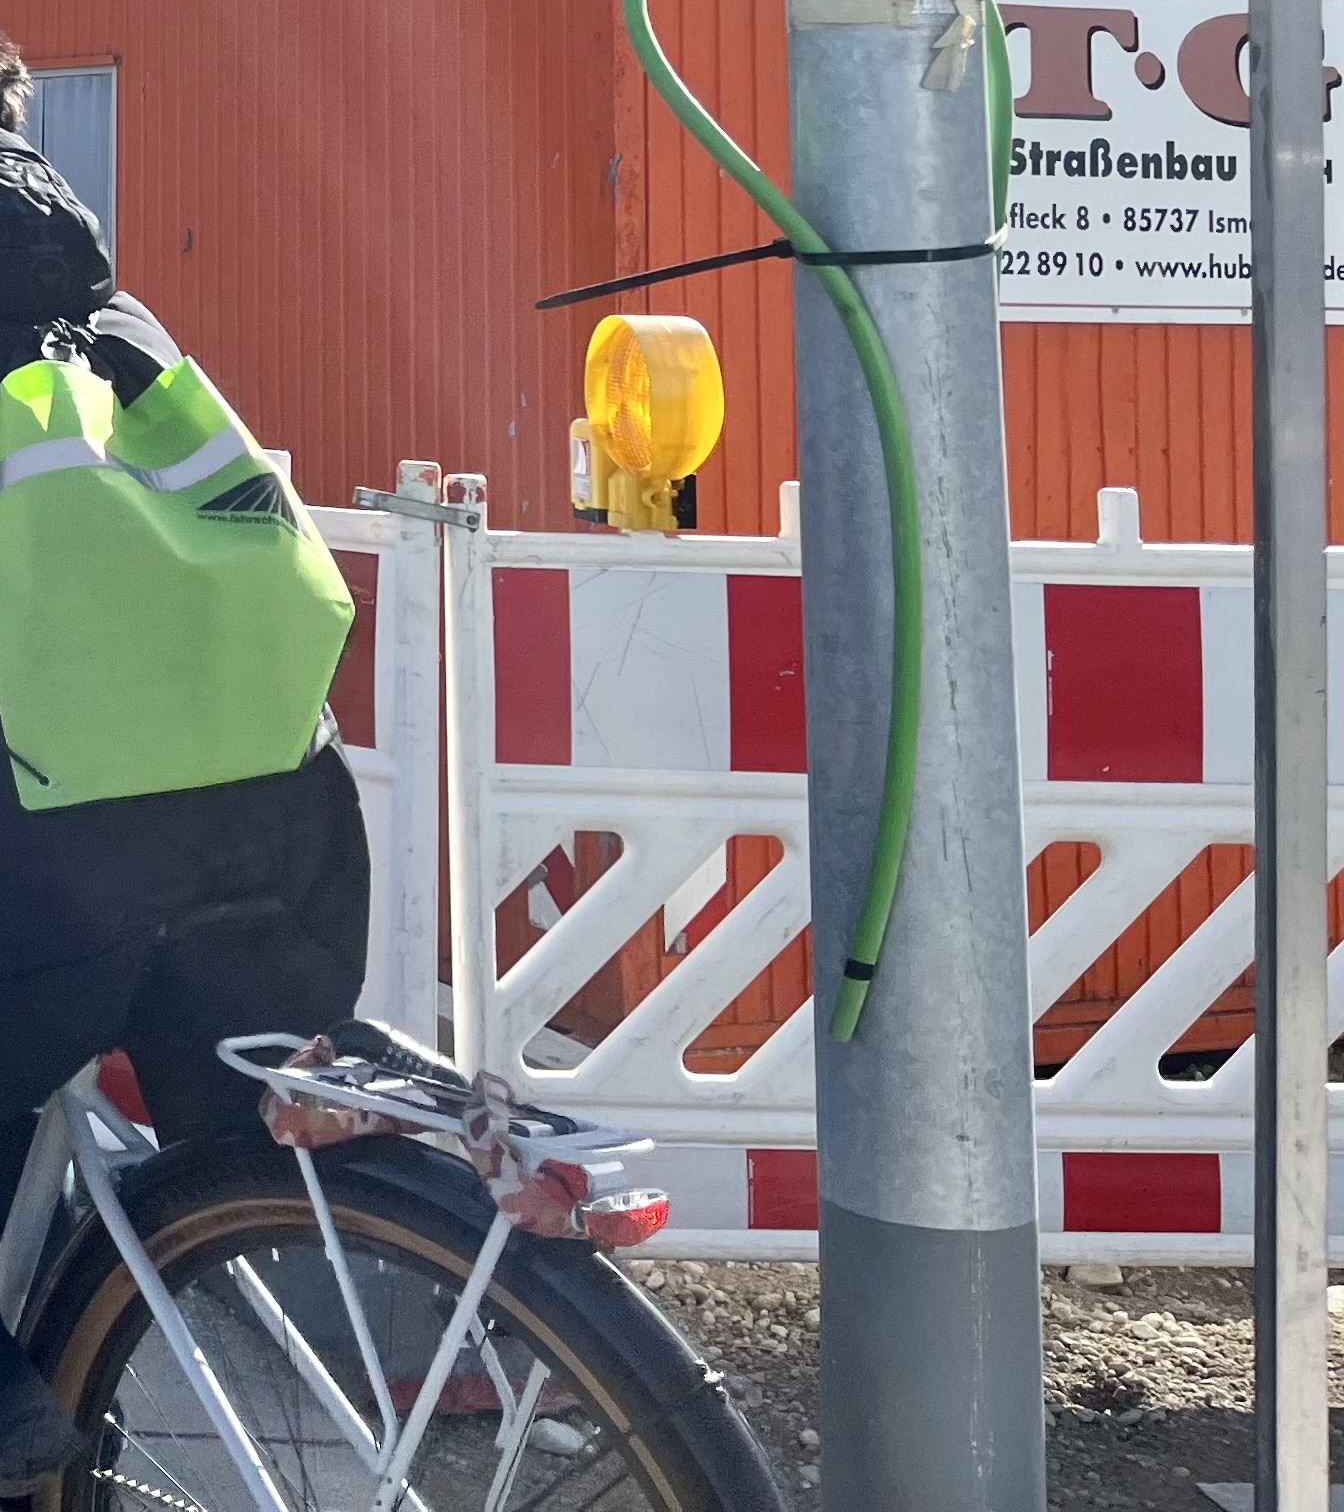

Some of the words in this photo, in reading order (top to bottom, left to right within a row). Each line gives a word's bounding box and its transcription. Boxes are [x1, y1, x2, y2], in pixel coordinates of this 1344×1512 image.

[1009, 138, 1237, 182] Straßenbau
[1009, 202, 1067, 230] fleck
[1075, 205, 1090, 231] 8
[1123, 207, 1199, 234] 85737
